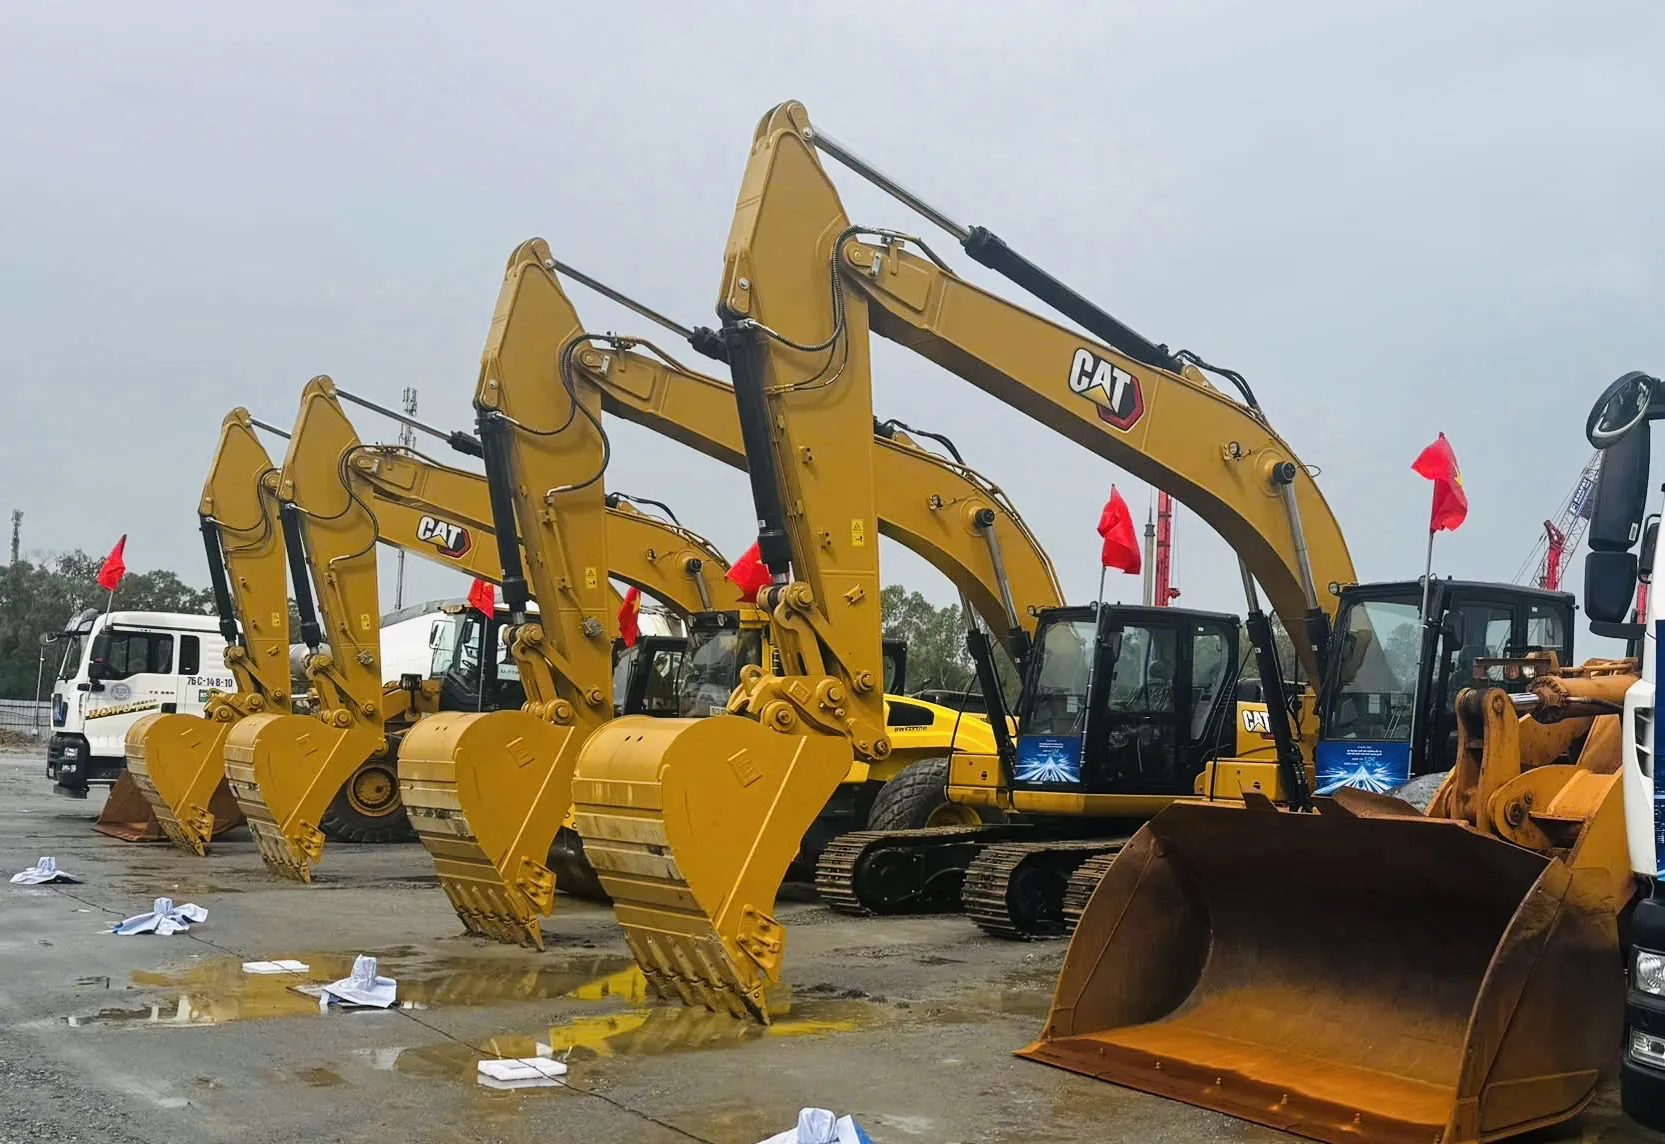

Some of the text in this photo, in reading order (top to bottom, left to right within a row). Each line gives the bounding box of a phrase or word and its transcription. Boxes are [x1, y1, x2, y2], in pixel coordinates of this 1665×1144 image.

[1069, 348, 1132, 413] CAT
[417, 516, 462, 550] CAT
[1242, 710, 1270, 733] CAT
